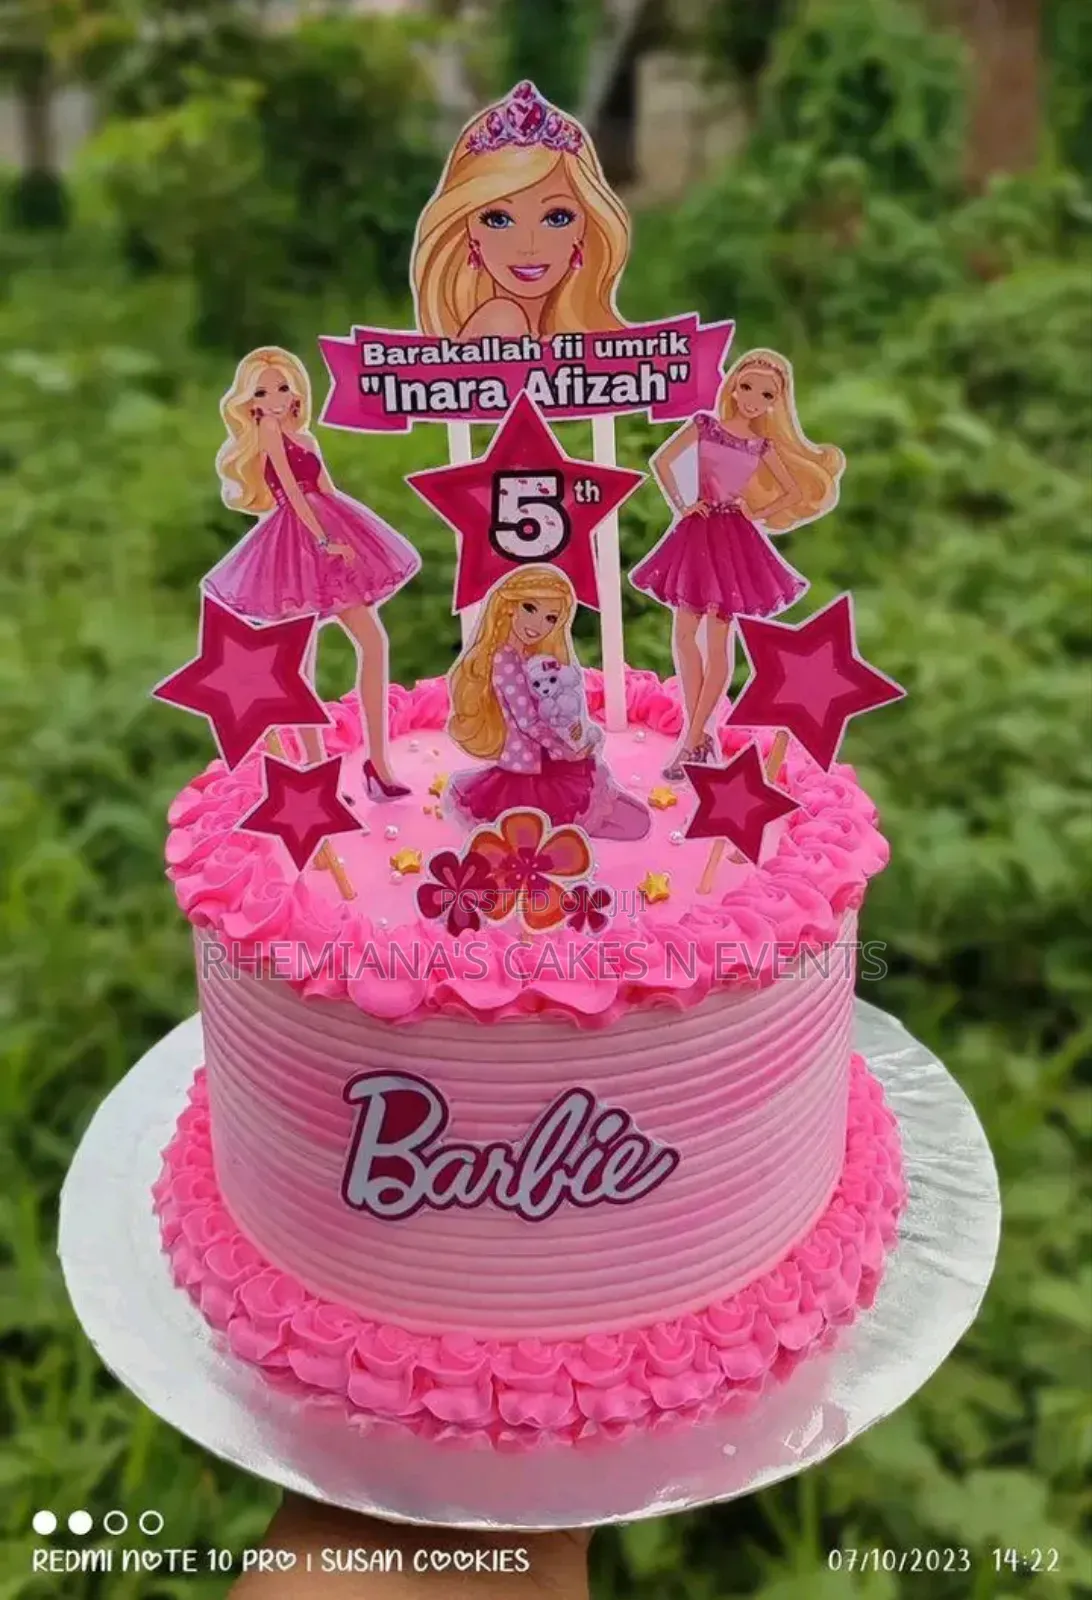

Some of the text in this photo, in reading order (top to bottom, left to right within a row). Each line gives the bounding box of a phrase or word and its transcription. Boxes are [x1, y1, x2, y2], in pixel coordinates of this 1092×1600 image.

[362, 332, 689, 366] Barakallah fii umrik
[360, 364, 688, 412] "Inara Afizah"
[489, 470, 600, 563] 5 th
[341, 1070, 681, 1222] Barbie
